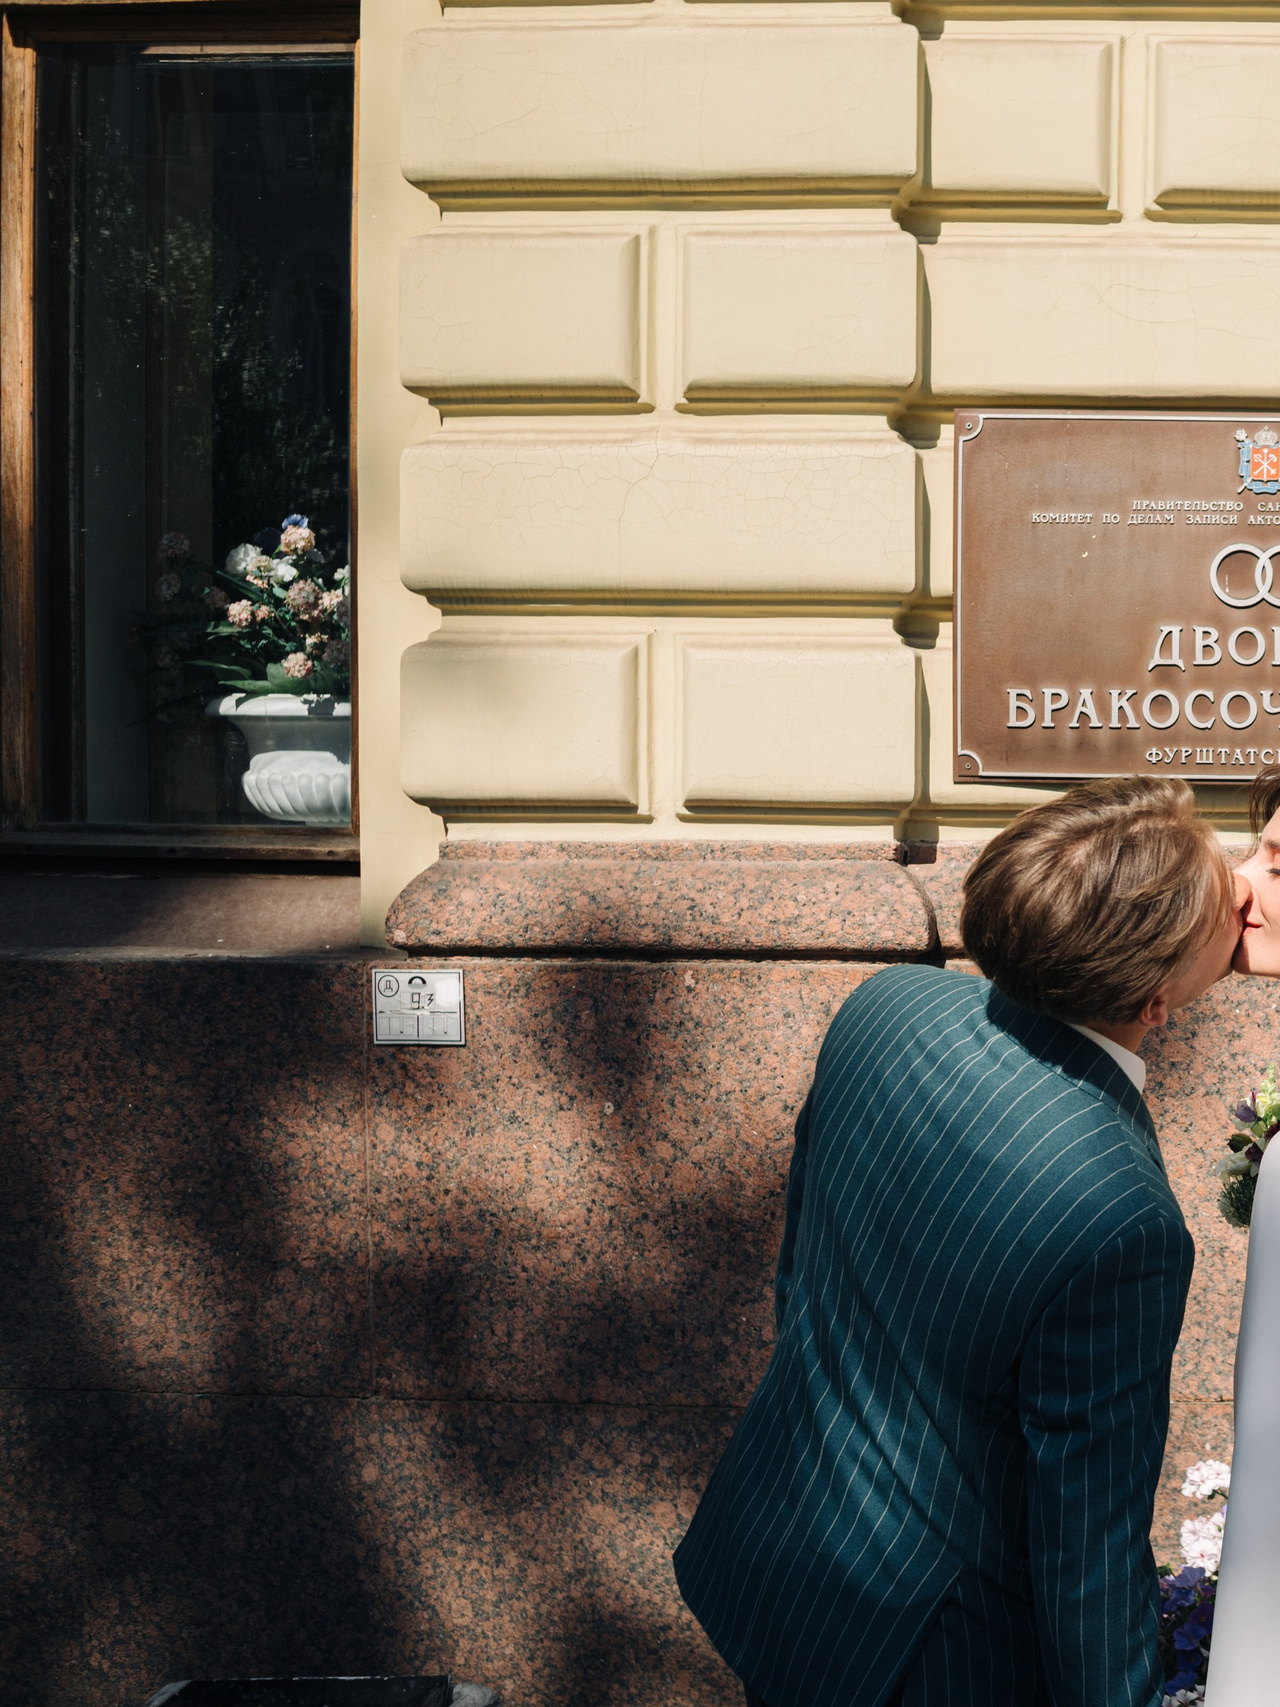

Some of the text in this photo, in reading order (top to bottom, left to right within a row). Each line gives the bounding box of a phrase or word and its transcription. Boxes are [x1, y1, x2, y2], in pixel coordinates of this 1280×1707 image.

[1132, 500, 1244, 512] ПРАВИТЕЛЬСТВО
[1031, 513, 1094, 525] КОМИТЕТ
[1102, 514, 1121, 525] ПО
[1127, 514, 1175, 526] ДЕЛАМ
[1185, 514, 1239, 526] ЗАПИСИ
